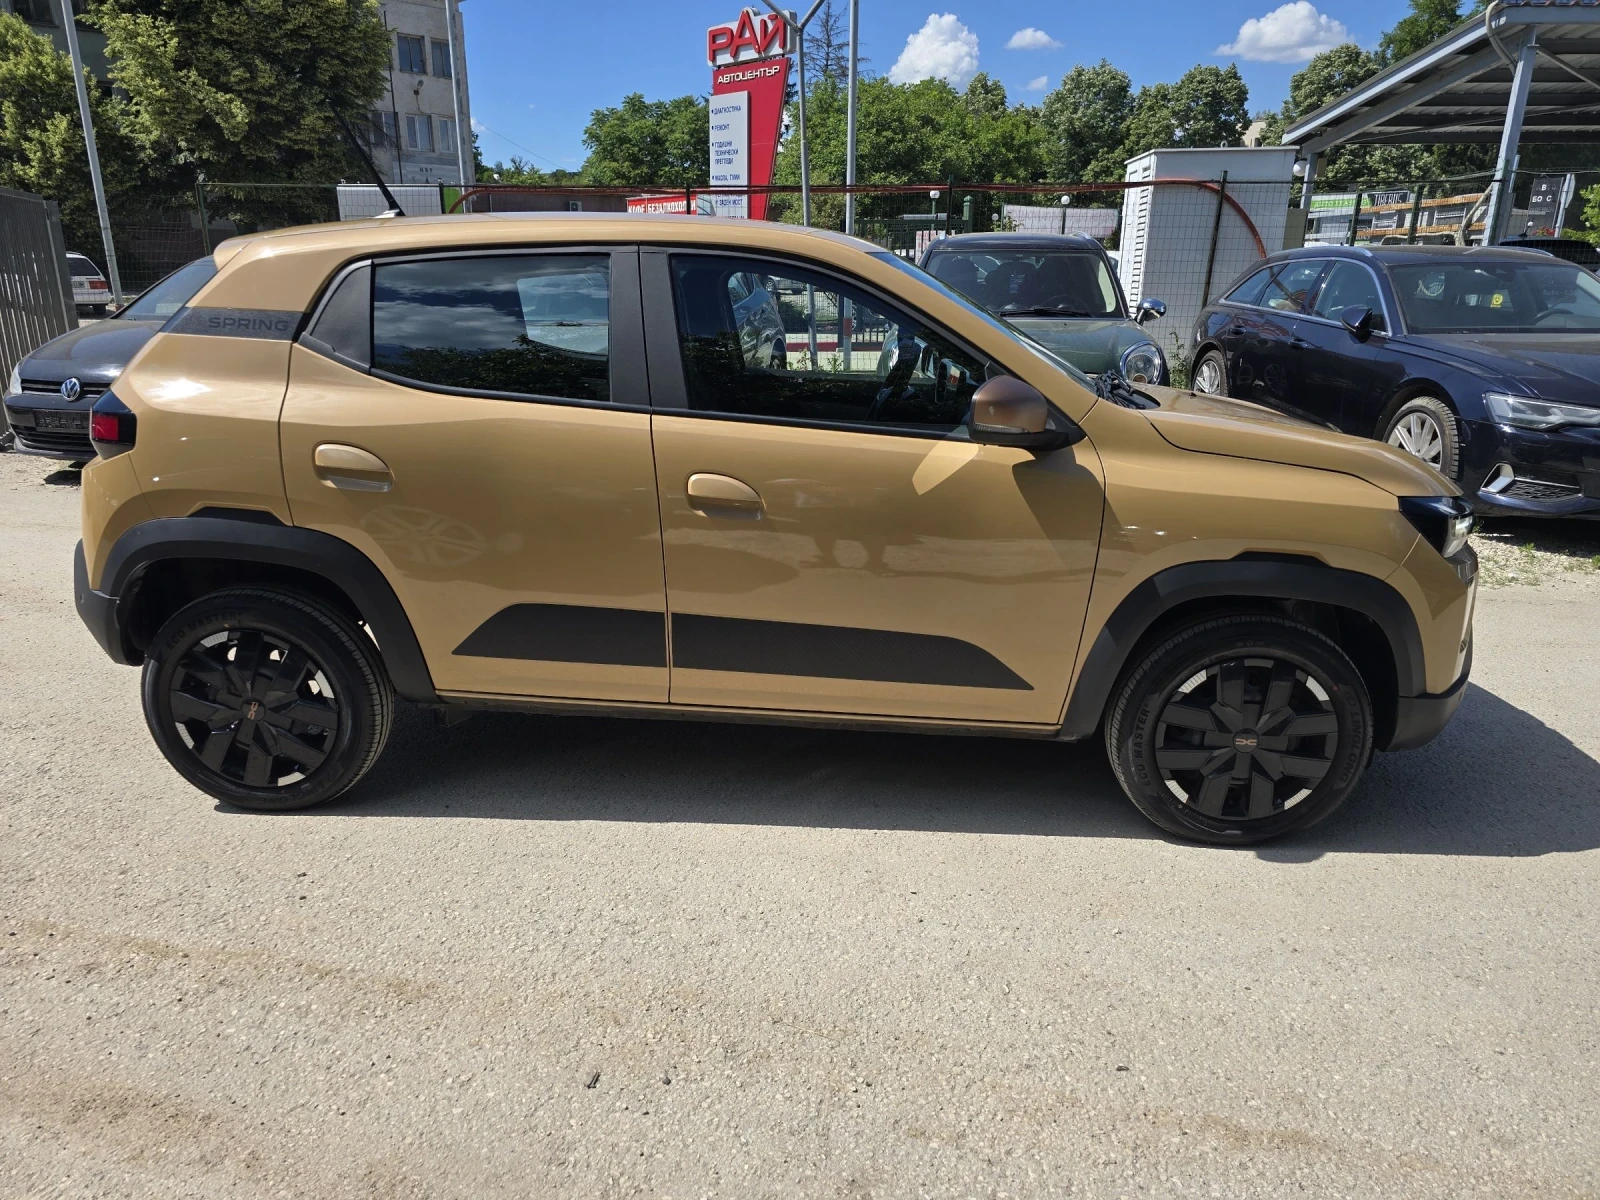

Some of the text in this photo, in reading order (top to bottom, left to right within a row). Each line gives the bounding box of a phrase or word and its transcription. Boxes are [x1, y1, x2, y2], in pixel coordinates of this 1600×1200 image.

[709, 10, 784, 62] РАЙ
[717, 66, 780, 84] АВТОЦЕНТЪР
[714, 123, 730, 131] РЕМОНТ
[1532, 195, 1553, 203] БОС
[628, 200, 696, 213] КАФЕ БЕЗАЛКОХОЛИ
[208, 317, 289, 331] SPRING
